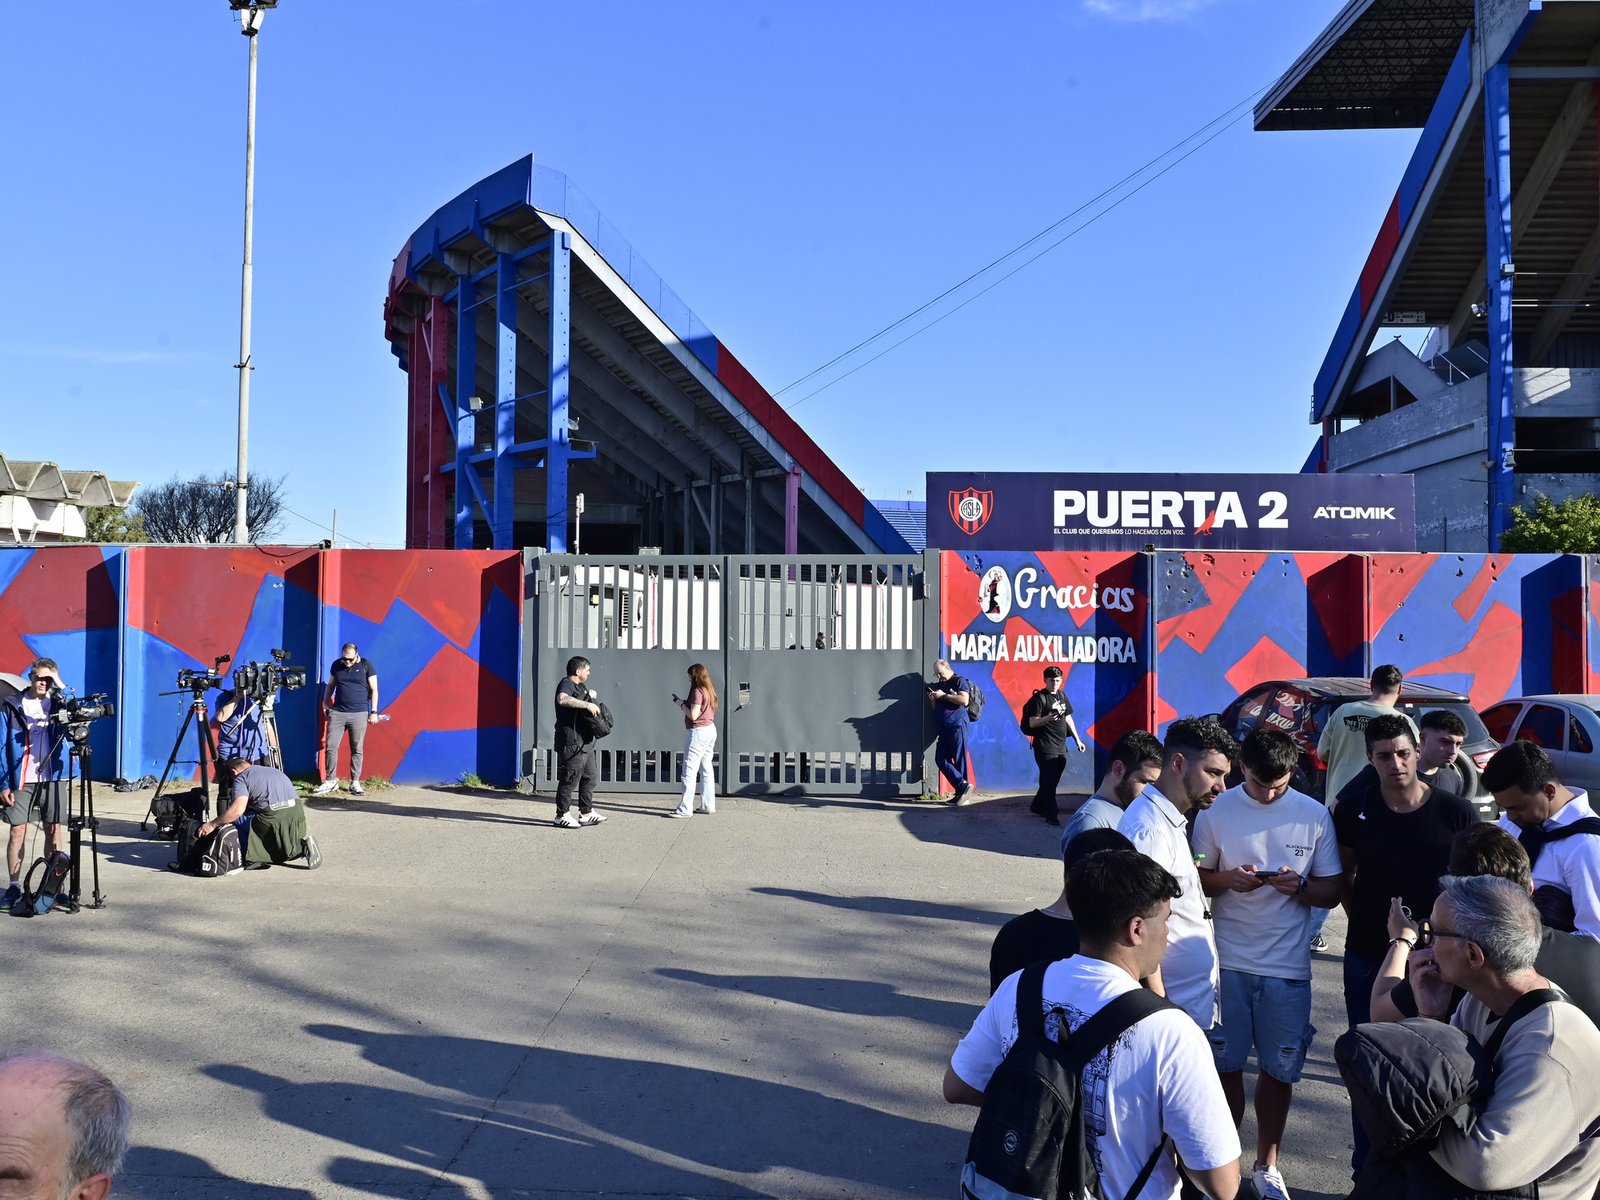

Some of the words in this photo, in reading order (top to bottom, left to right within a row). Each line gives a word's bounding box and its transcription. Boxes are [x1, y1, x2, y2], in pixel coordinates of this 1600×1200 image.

[1053, 490, 1248, 528] PUERTA
[1258, 491, 1289, 528] 2
[1313, 506, 1396, 520] ATOMIK
[1132, 528, 1159, 536] HACEMOS
[1014, 567, 1135, 613] Gracias
[950, 633, 1010, 662] MARIA
[1013, 634, 1137, 663] AUXILIADORA
[1294, 849, 1304, 857] 23
